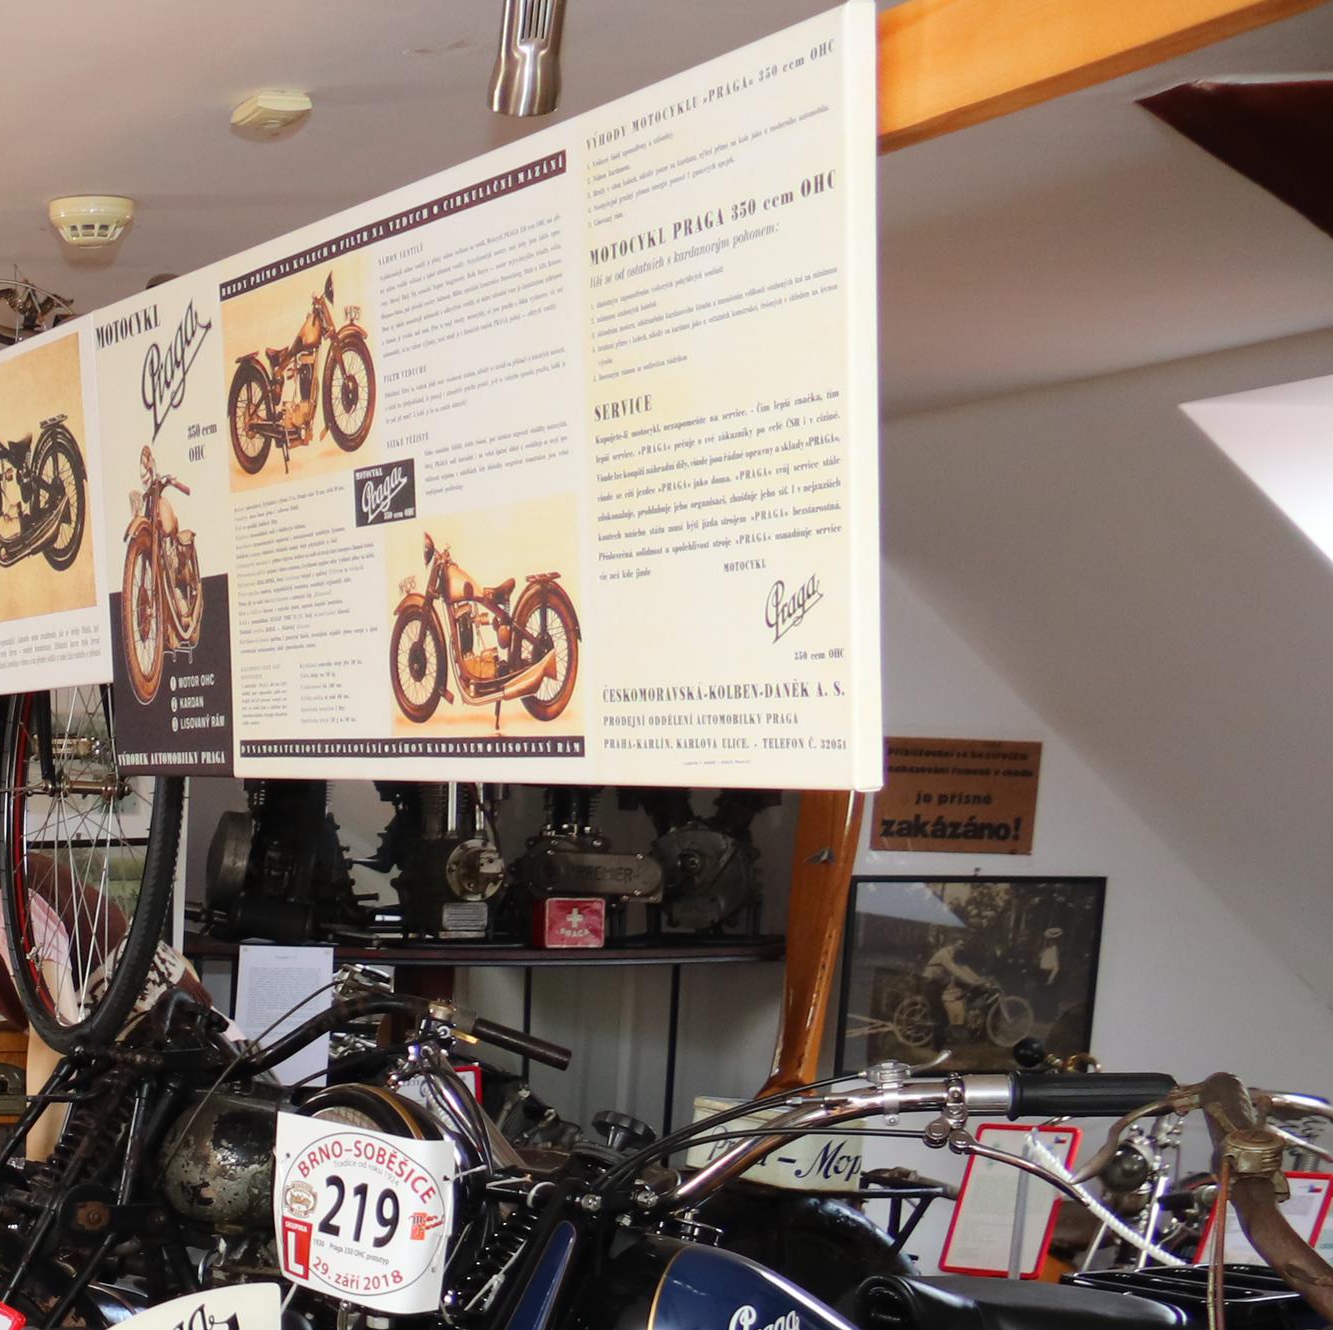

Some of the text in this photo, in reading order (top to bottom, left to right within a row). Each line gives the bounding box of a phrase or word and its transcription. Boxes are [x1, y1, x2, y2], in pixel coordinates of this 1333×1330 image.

[586, 125, 627, 150] VÝHODY
[633, 96, 699, 132] MOTOCYKLU
[759, 65, 778, 82] 350
[783, 57, 805, 73] ccm
[810, 39, 835, 61] OHC
[590, 169, 836, 265] MOTOCYKL PRAGA 350 ccm OHC
[221, 278, 248, 297] BRZDY
[251, 267, 277, 286] PŘÍMO
[280, 263, 290, 275] NA
[293, 248, 328, 270] KOLECH
[340, 231, 368, 251] FILTR
[372, 227, 384, 240] NA
[389, 207, 429, 232] VZDUCH
[443, 175, 514, 211] CIRKULAČNÍ
[518, 154, 564, 184] MAZÁNÍ
[615, 267, 625, 281] od
[627, 258, 664, 279] ostatních
[732, 221, 780, 249] pohonem:
[96, 304, 161, 349] MOTOCYKL
[142, 296, 212, 446] Praga
[595, 394, 652, 422] SERVICE
[722, 408, 748, 420] service.
[795, 394, 822, 406] značka,
[187, 423, 217, 439] 350 ccm
[718, 428, 753, 441] zákazníky
[756, 425, 765, 436] po
[189, 445, 205, 462] OHC
[355, 468, 383, 480] MOTOCYKL
[694, 477, 708, 490] jako
[362, 466, 407, 524] Praga
[724, 558, 766, 573] MOTOCYKL
[765, 573, 823, 644] Praga
[794, 650, 808, 661] 350
[828, 648, 845, 659] OHC
[178, 673, 215, 689] MOTOR OHC
[603, 679, 845, 703] ČESKOMORAVSKÁ-KOLBEN-DANĚK A. S.
[180, 696, 204, 709] KARDAN
[180, 714, 225, 730] LISOVANÝ RÁM
[603, 712, 798, 728] PRODEJNÍ ODDĚLENÍ AUTOMOBILKY PRAGA
[325, 741, 382, 754] ZAPALOVÁNÍ
[392, 741, 423, 753] NÁHON
[427, 742, 484, 753] KARDANEM
[495, 740, 552, 753] LISOVANÝ
[557, 740, 580, 753] RÁM
[677, 738, 717, 750] KARLOVA
[722, 737, 749, 749] ULICE.
[762, 737, 805, 749] TELEFON
[809, 736, 817, 749] Č.
[821, 738, 847, 750] 32051
[118, 751, 225, 766] VÝROBEK AUTOMOBILKY PRAGA
[915, 791, 933, 805] je
[880, 814, 1021, 841] zakázáno!
[560, 927, 589, 937] PRAGA
[318, 1175, 400, 1248] 219
[313, 1256, 404, 1290] 29. září 2018
